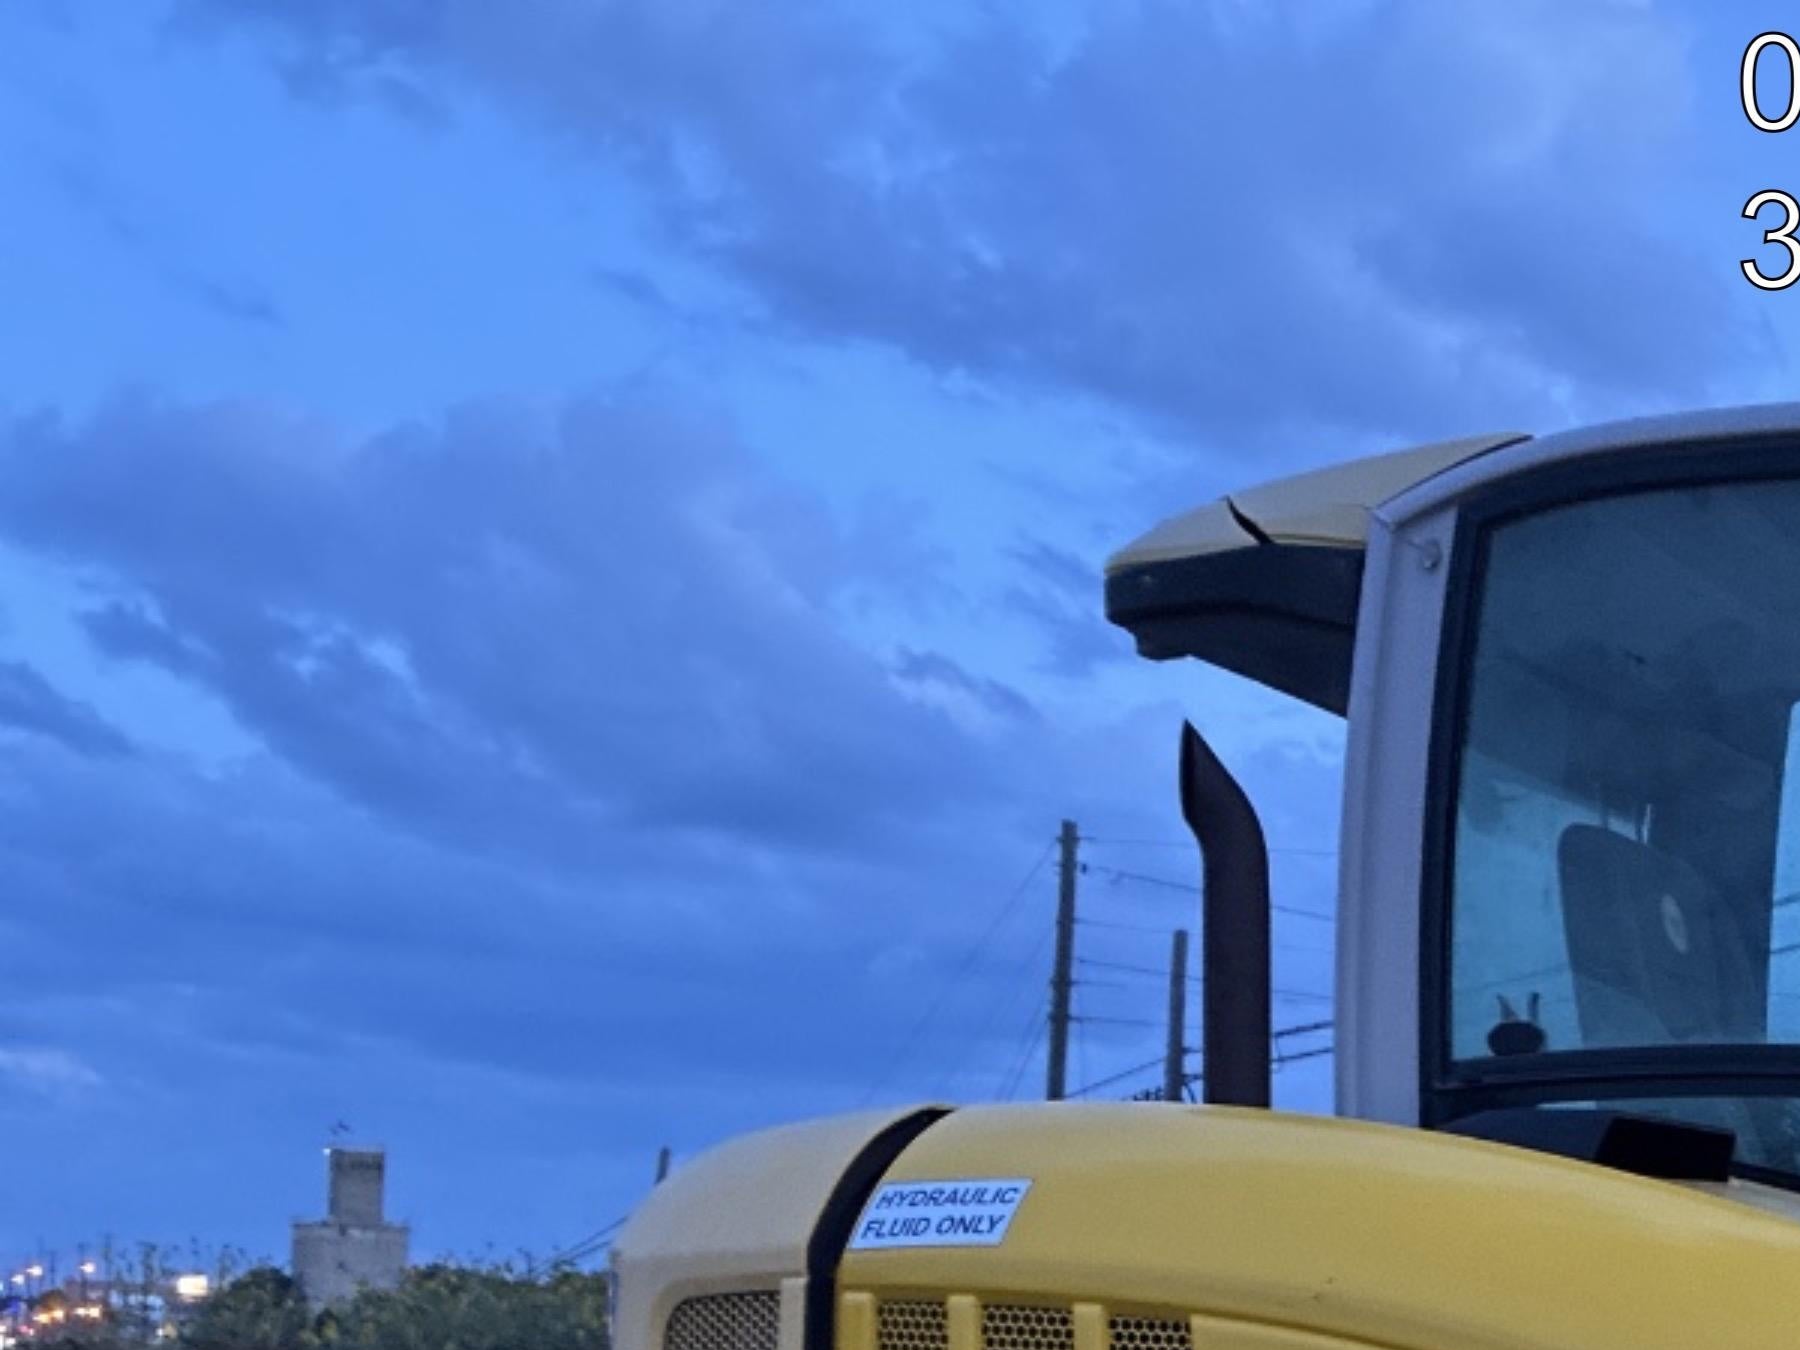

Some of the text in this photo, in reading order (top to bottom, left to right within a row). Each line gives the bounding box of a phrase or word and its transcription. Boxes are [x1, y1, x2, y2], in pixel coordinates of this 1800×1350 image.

[875, 1186, 1020, 1210] HYDRAULIC
[861, 1214, 1005, 1240] FLUID ONLY
